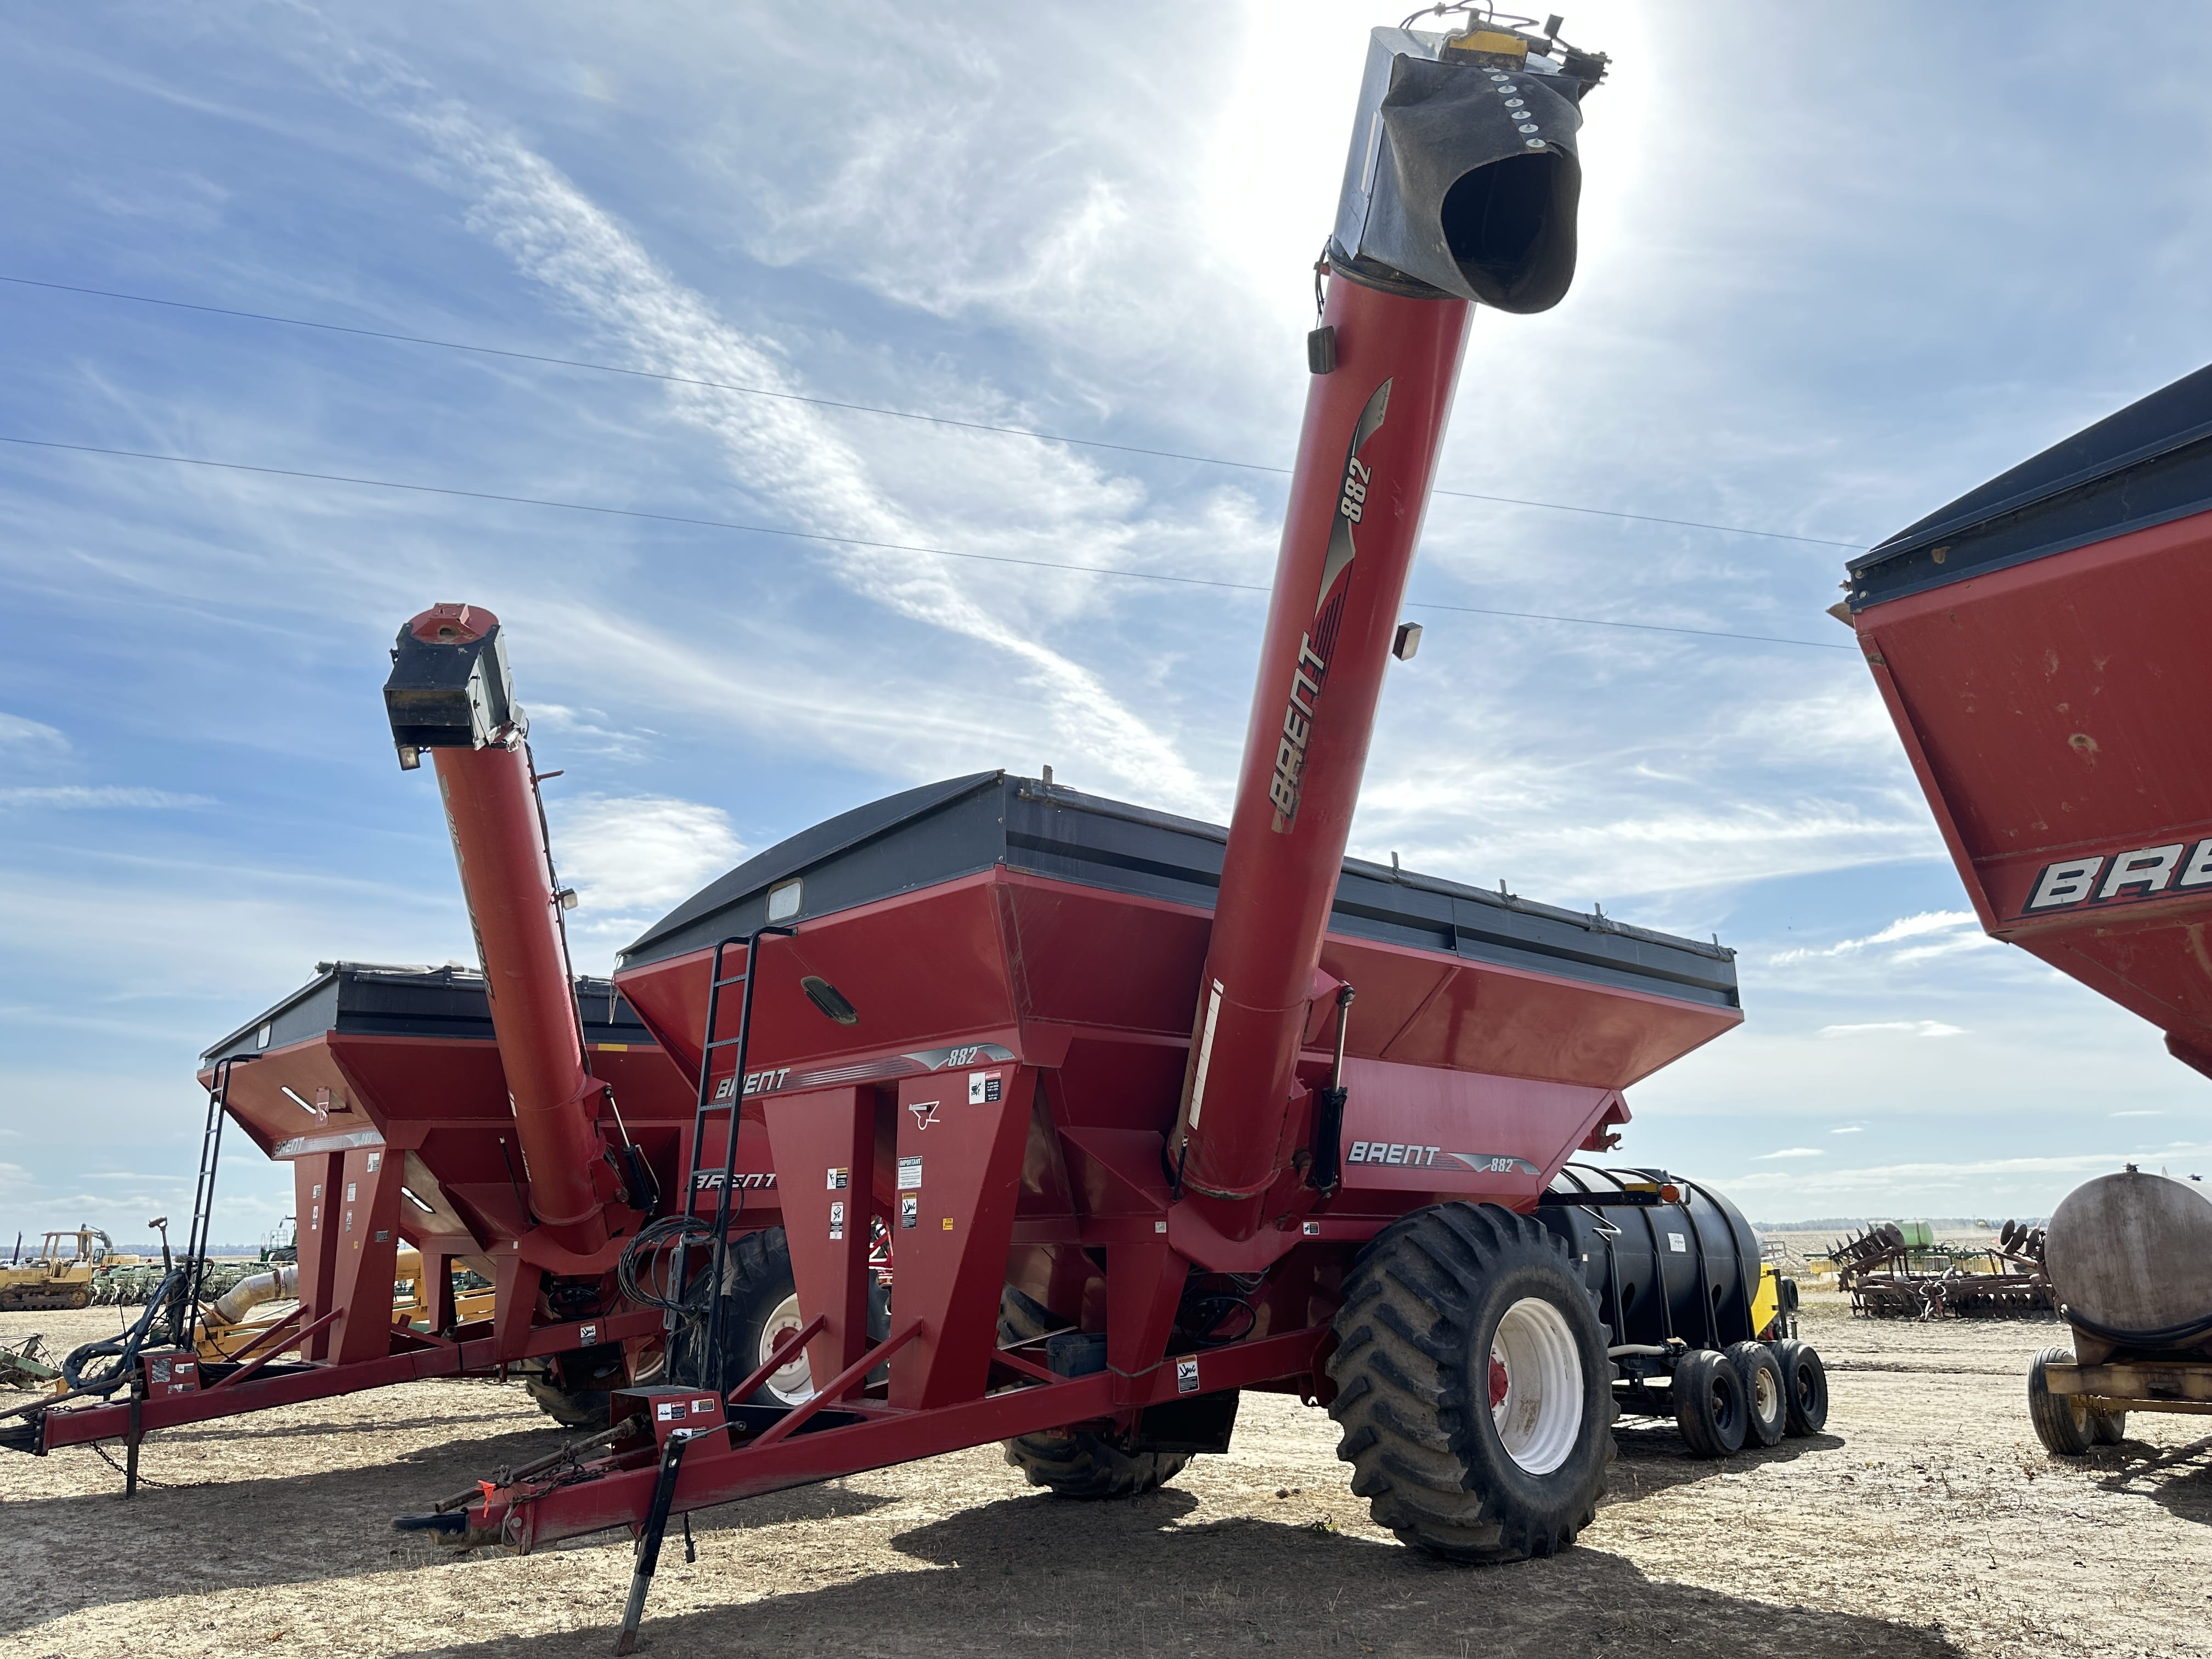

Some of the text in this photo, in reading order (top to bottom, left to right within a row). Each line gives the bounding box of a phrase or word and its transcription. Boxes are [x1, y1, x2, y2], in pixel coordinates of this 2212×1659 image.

[1340, 456, 1371, 523] 882
[1269, 631, 1325, 815] BRENT
[947, 1047, 978, 1067] 882
[900, 1158, 921, 1166] IMPORTANT
[1348, 1141, 1514, 1173] BRENT 882
